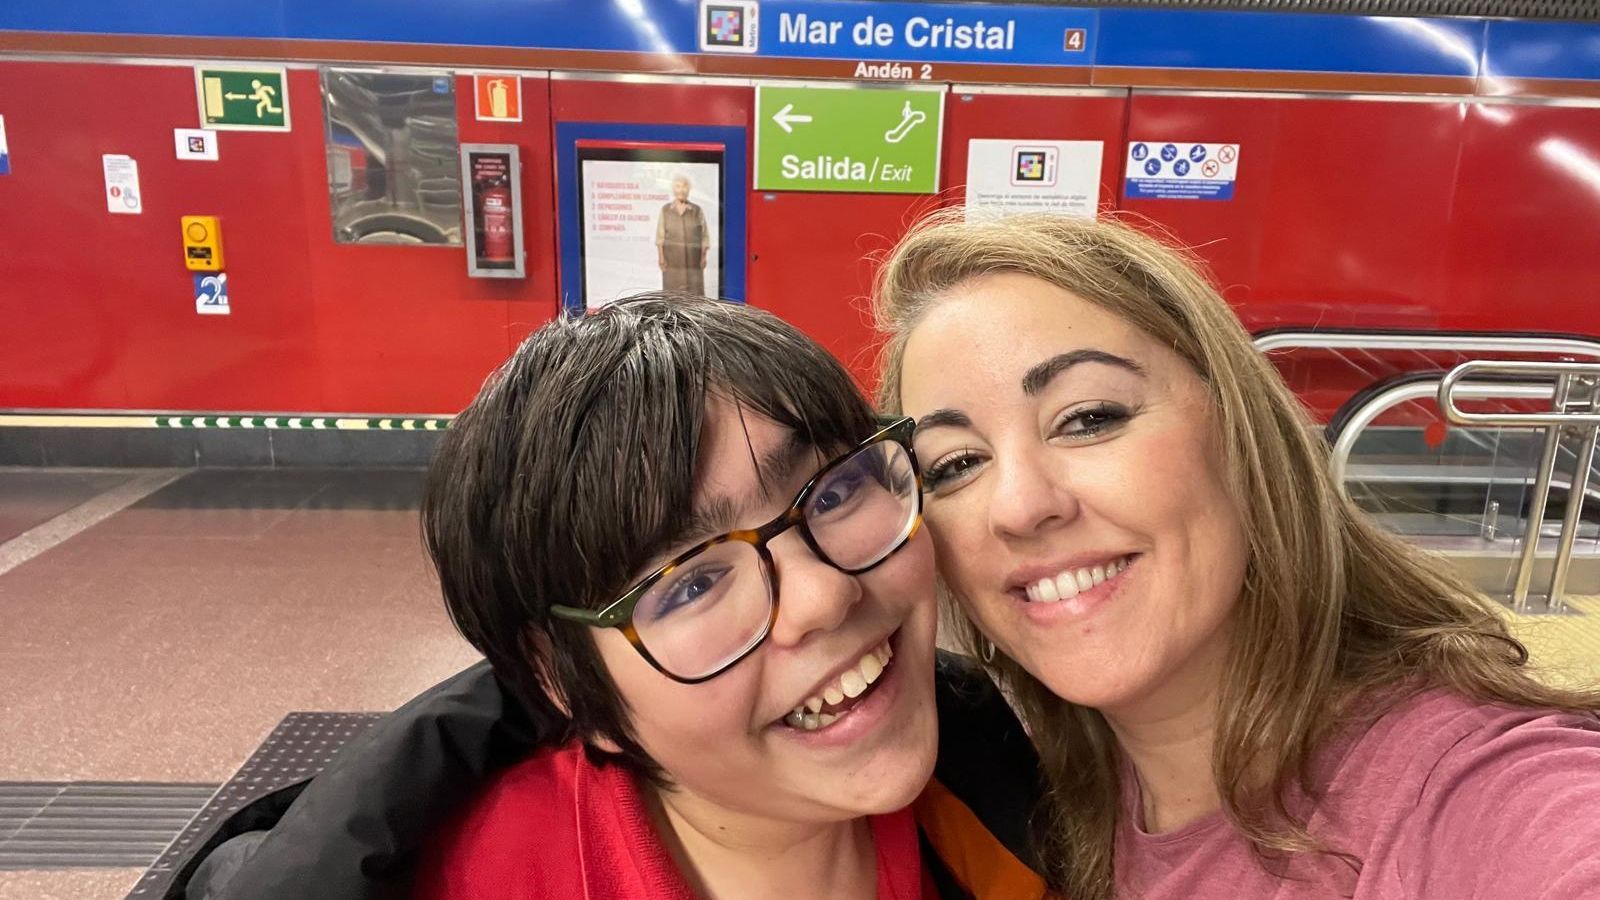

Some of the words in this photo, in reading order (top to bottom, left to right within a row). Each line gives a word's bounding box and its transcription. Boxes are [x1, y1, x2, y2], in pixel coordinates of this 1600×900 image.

[779, 12, 842, 45] Mar
[852, 16, 894, 47] de
[904, 17, 1016, 50] Cristal
[1068, 31, 1081, 49] 4
[854, 61, 912, 80] Andén
[921, 63, 932, 80] 2
